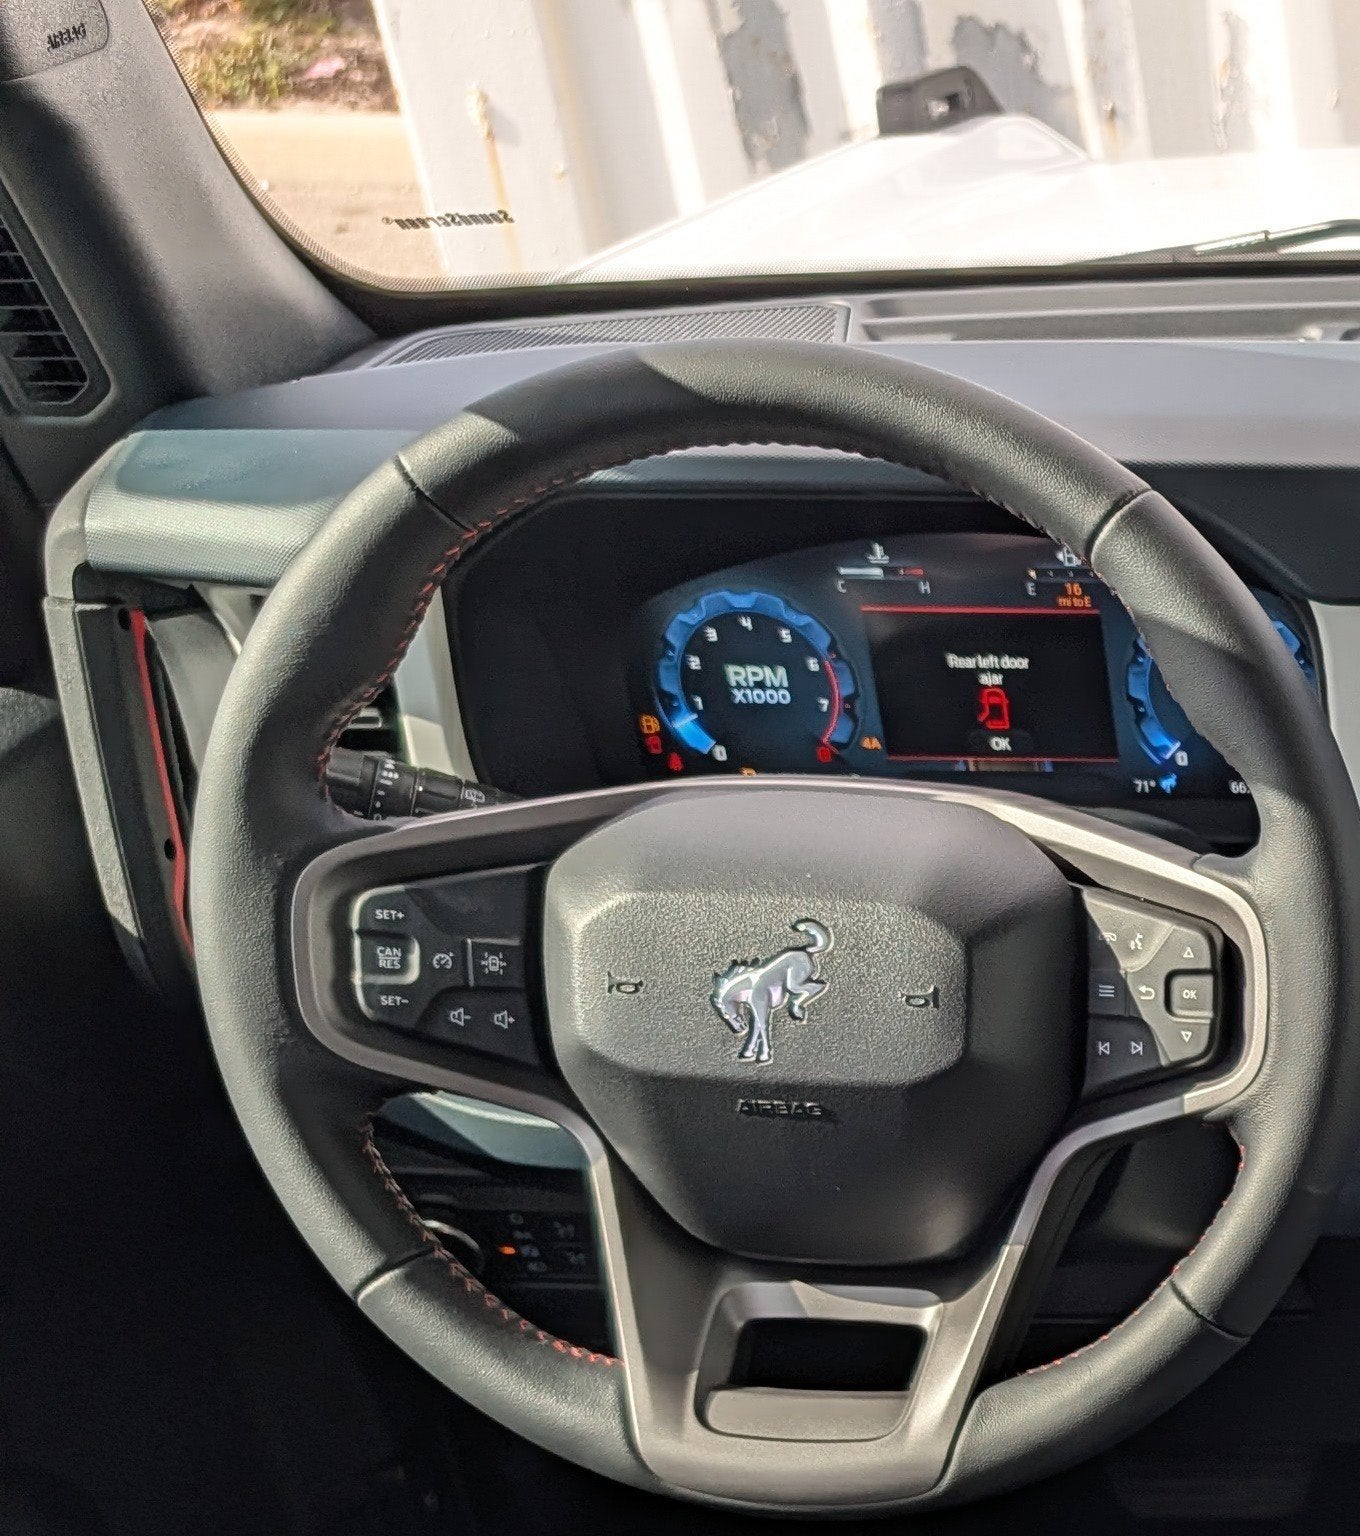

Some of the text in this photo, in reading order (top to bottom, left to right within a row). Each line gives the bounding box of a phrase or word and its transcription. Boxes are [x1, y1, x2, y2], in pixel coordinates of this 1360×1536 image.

[724, 663, 789, 688] RPM
[730, 688, 791, 705] X1000
[989, 736, 1012, 752] OK
[374, 908, 405, 921] SET+
[376, 946, 402, 957] CAN
[379, 959, 401, 970] RES
[1182, 989, 1197, 1000] OK
